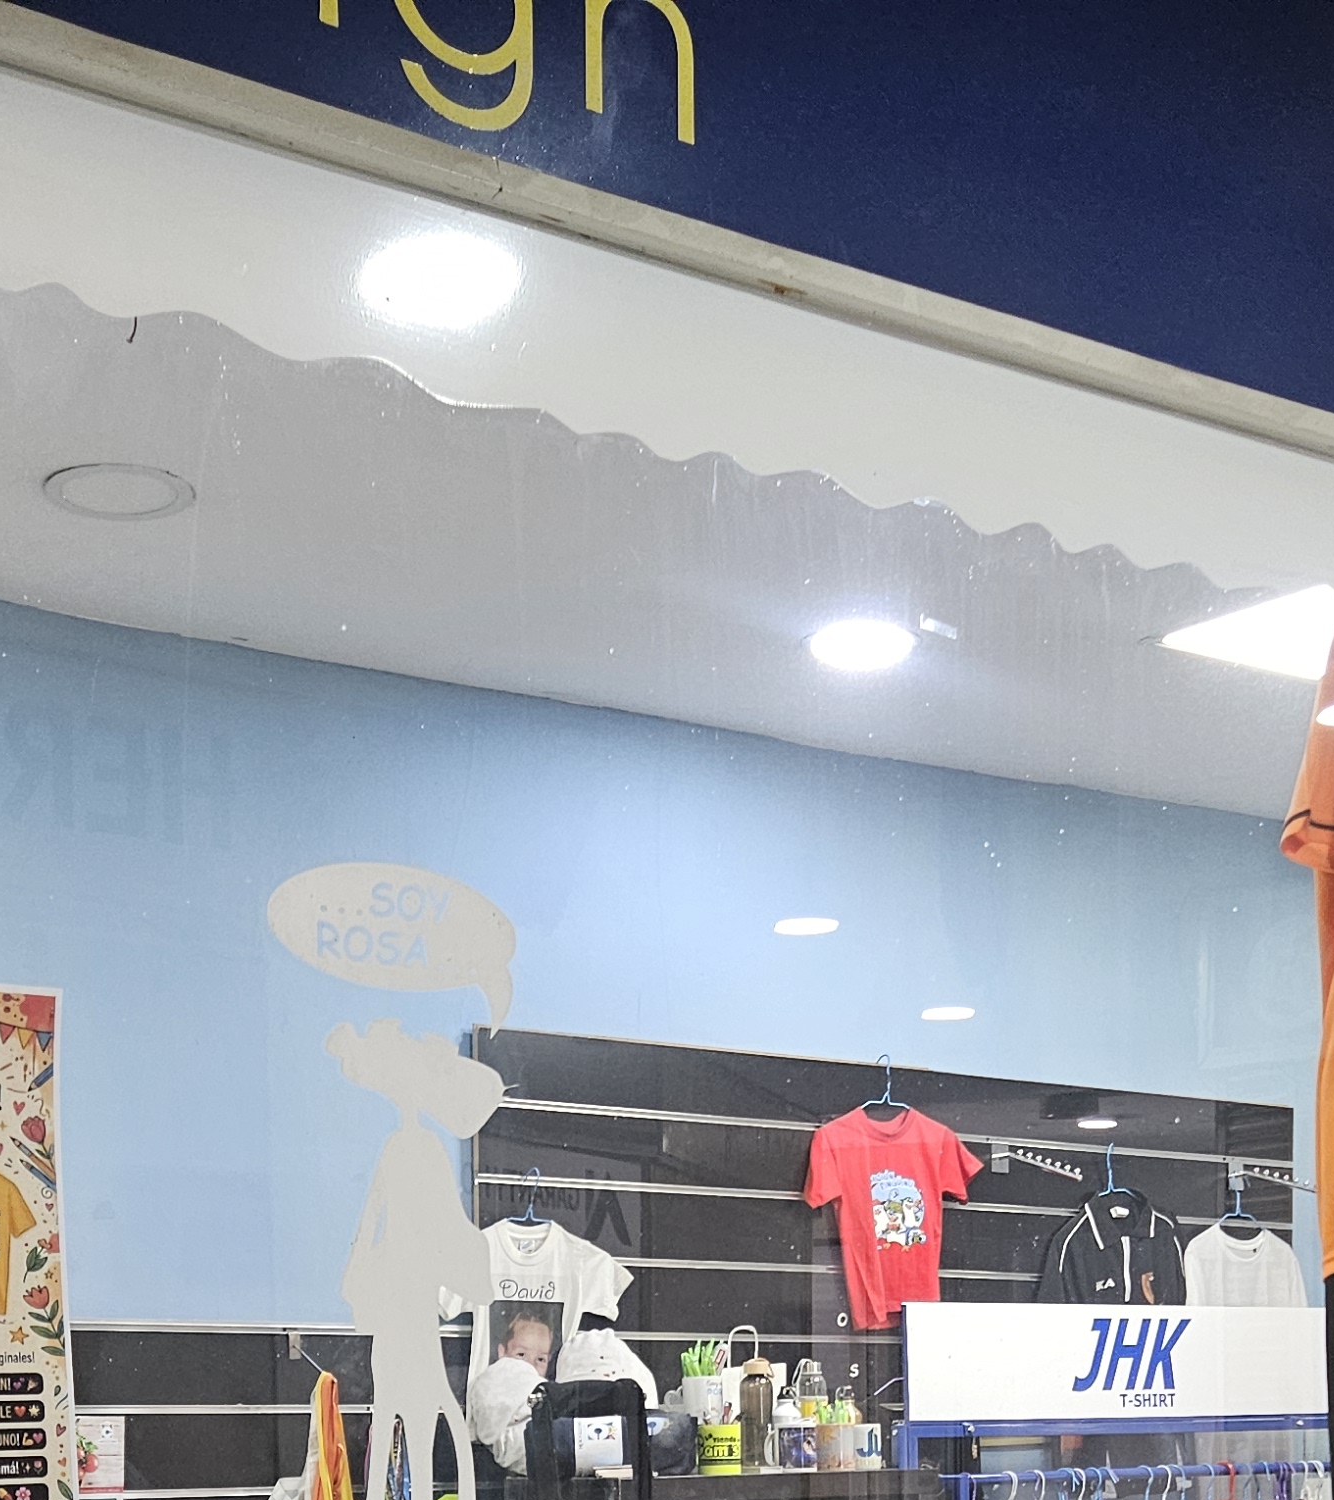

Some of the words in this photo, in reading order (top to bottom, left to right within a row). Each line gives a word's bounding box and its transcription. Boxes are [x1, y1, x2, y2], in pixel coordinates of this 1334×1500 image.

[368, 881, 451, 925] SOY
[316, 919, 429, 967] ROSA
[498, 1279, 556, 1301] David
[1071, 1317, 1192, 1394] JHK
[1119, 1391, 1178, 1410] T-SHIRT
